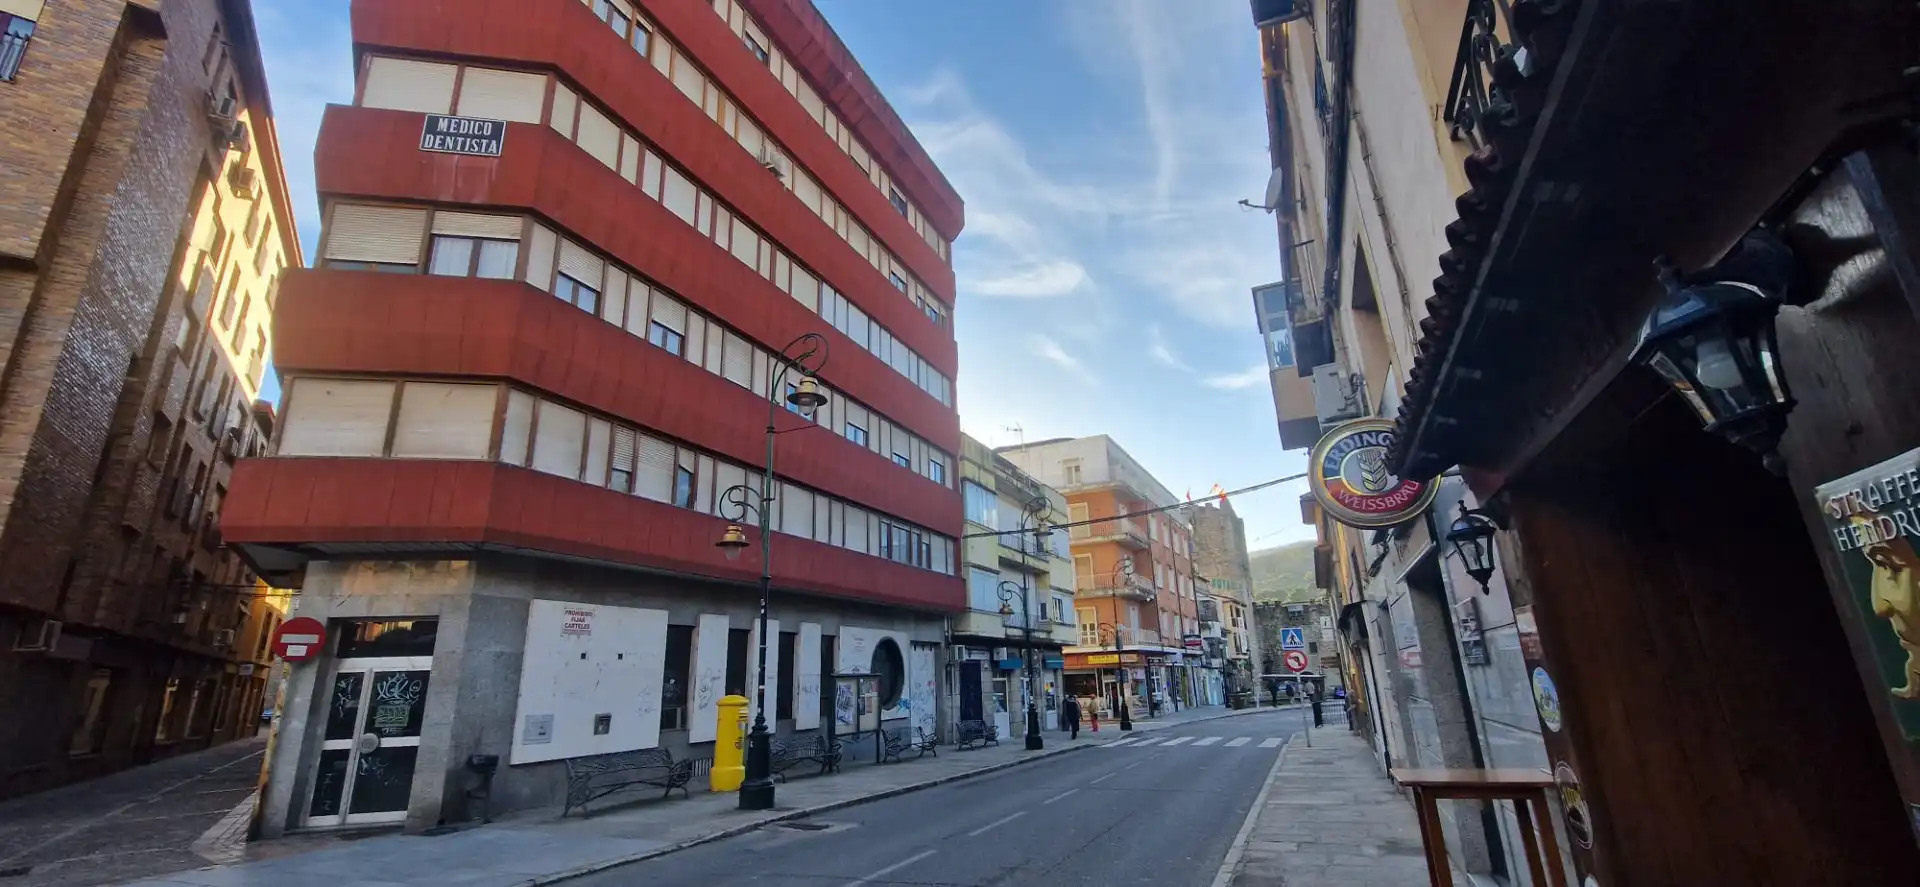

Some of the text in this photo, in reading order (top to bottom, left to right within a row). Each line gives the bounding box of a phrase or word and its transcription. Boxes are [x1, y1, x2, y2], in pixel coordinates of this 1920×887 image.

[438, 118, 492, 135] MEDICO
[424, 134, 497, 153] DENTISTA
[1325, 431, 1394, 470] ERDING
[1833, 498, 1920, 551] HENDRI
